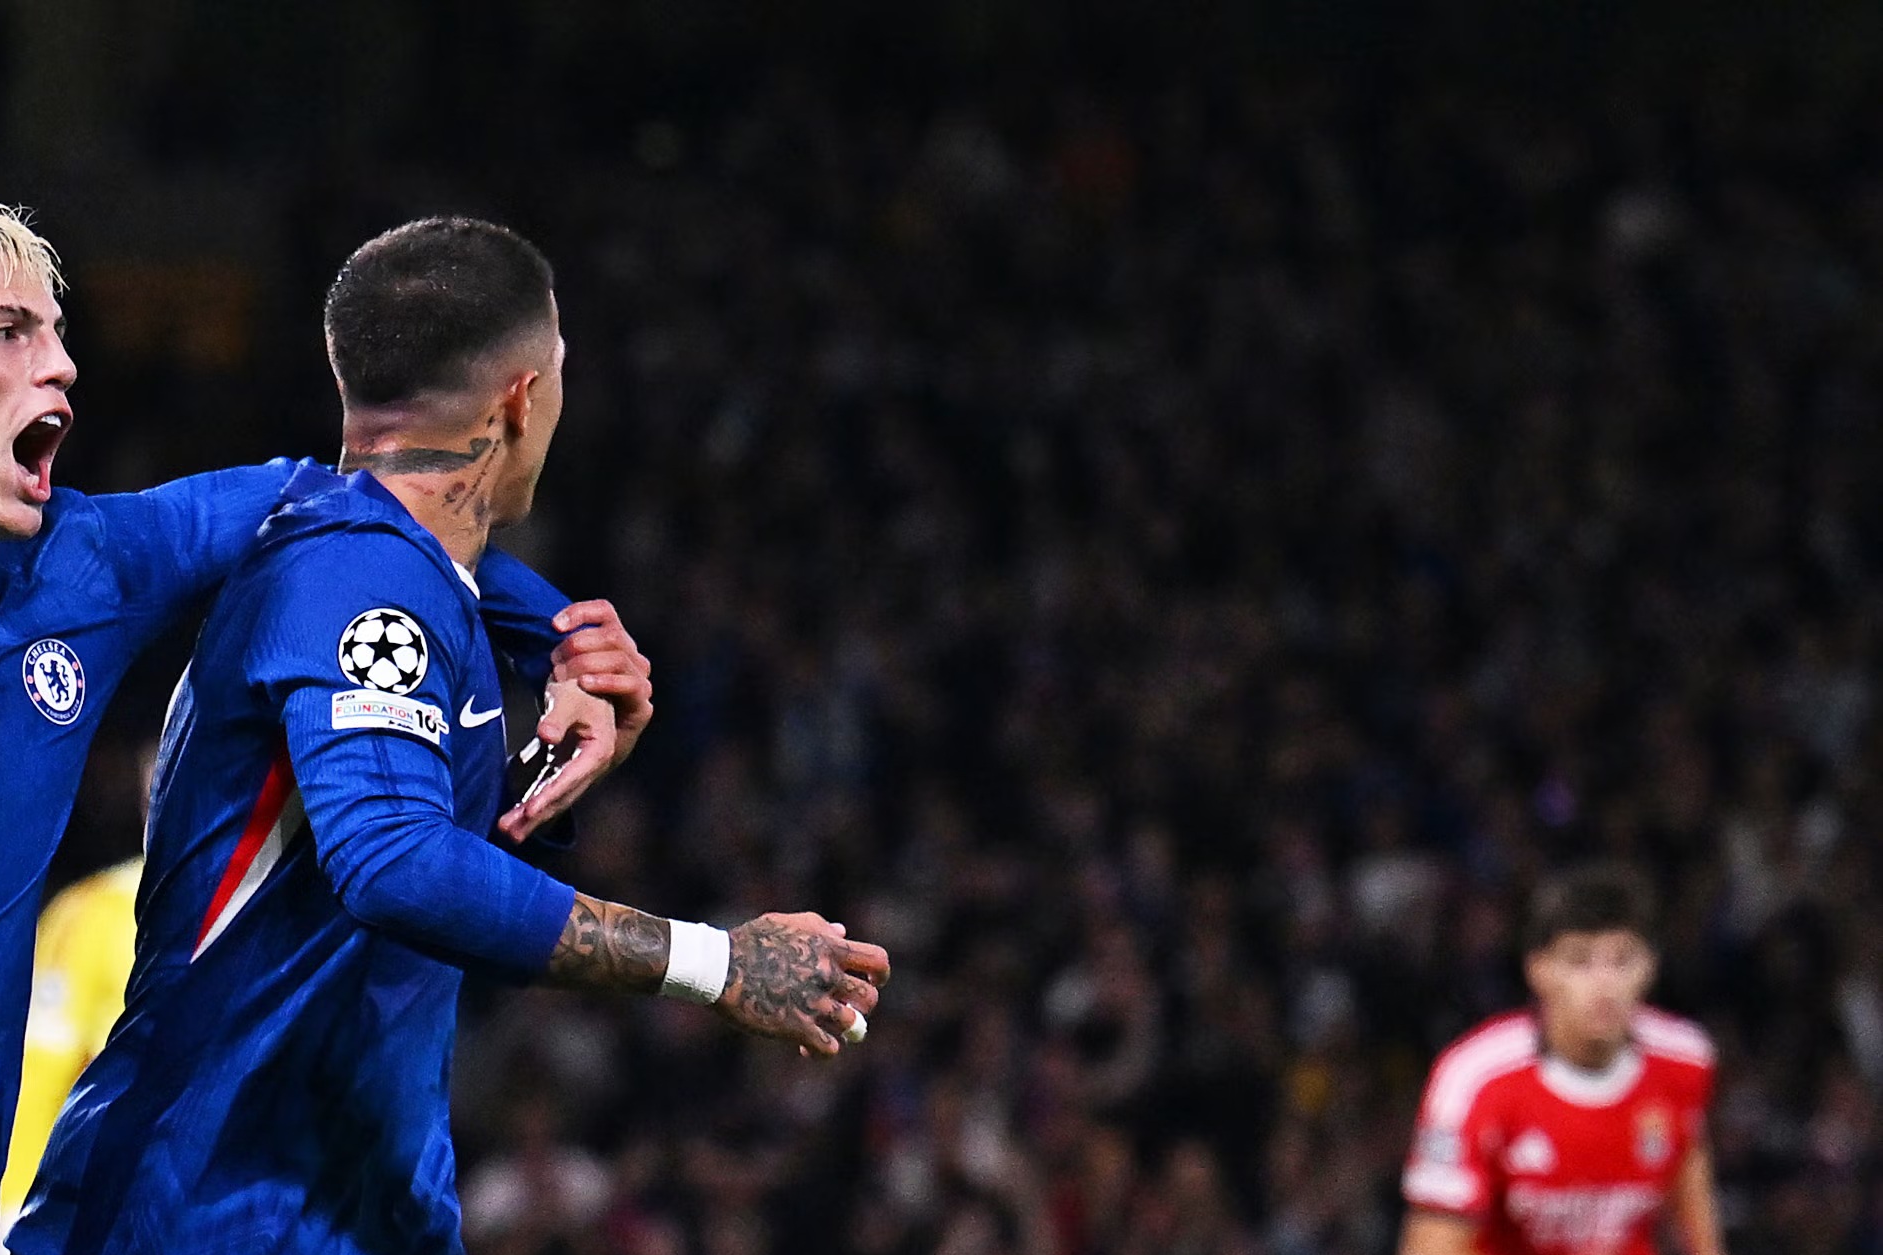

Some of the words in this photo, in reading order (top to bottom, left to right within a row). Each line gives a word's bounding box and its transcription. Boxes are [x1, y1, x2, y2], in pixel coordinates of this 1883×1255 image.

[27, 641, 66, 665] CHELSEA
[335, 703, 414, 720] FOUNDATION
[416, 709, 437, 734] 10
